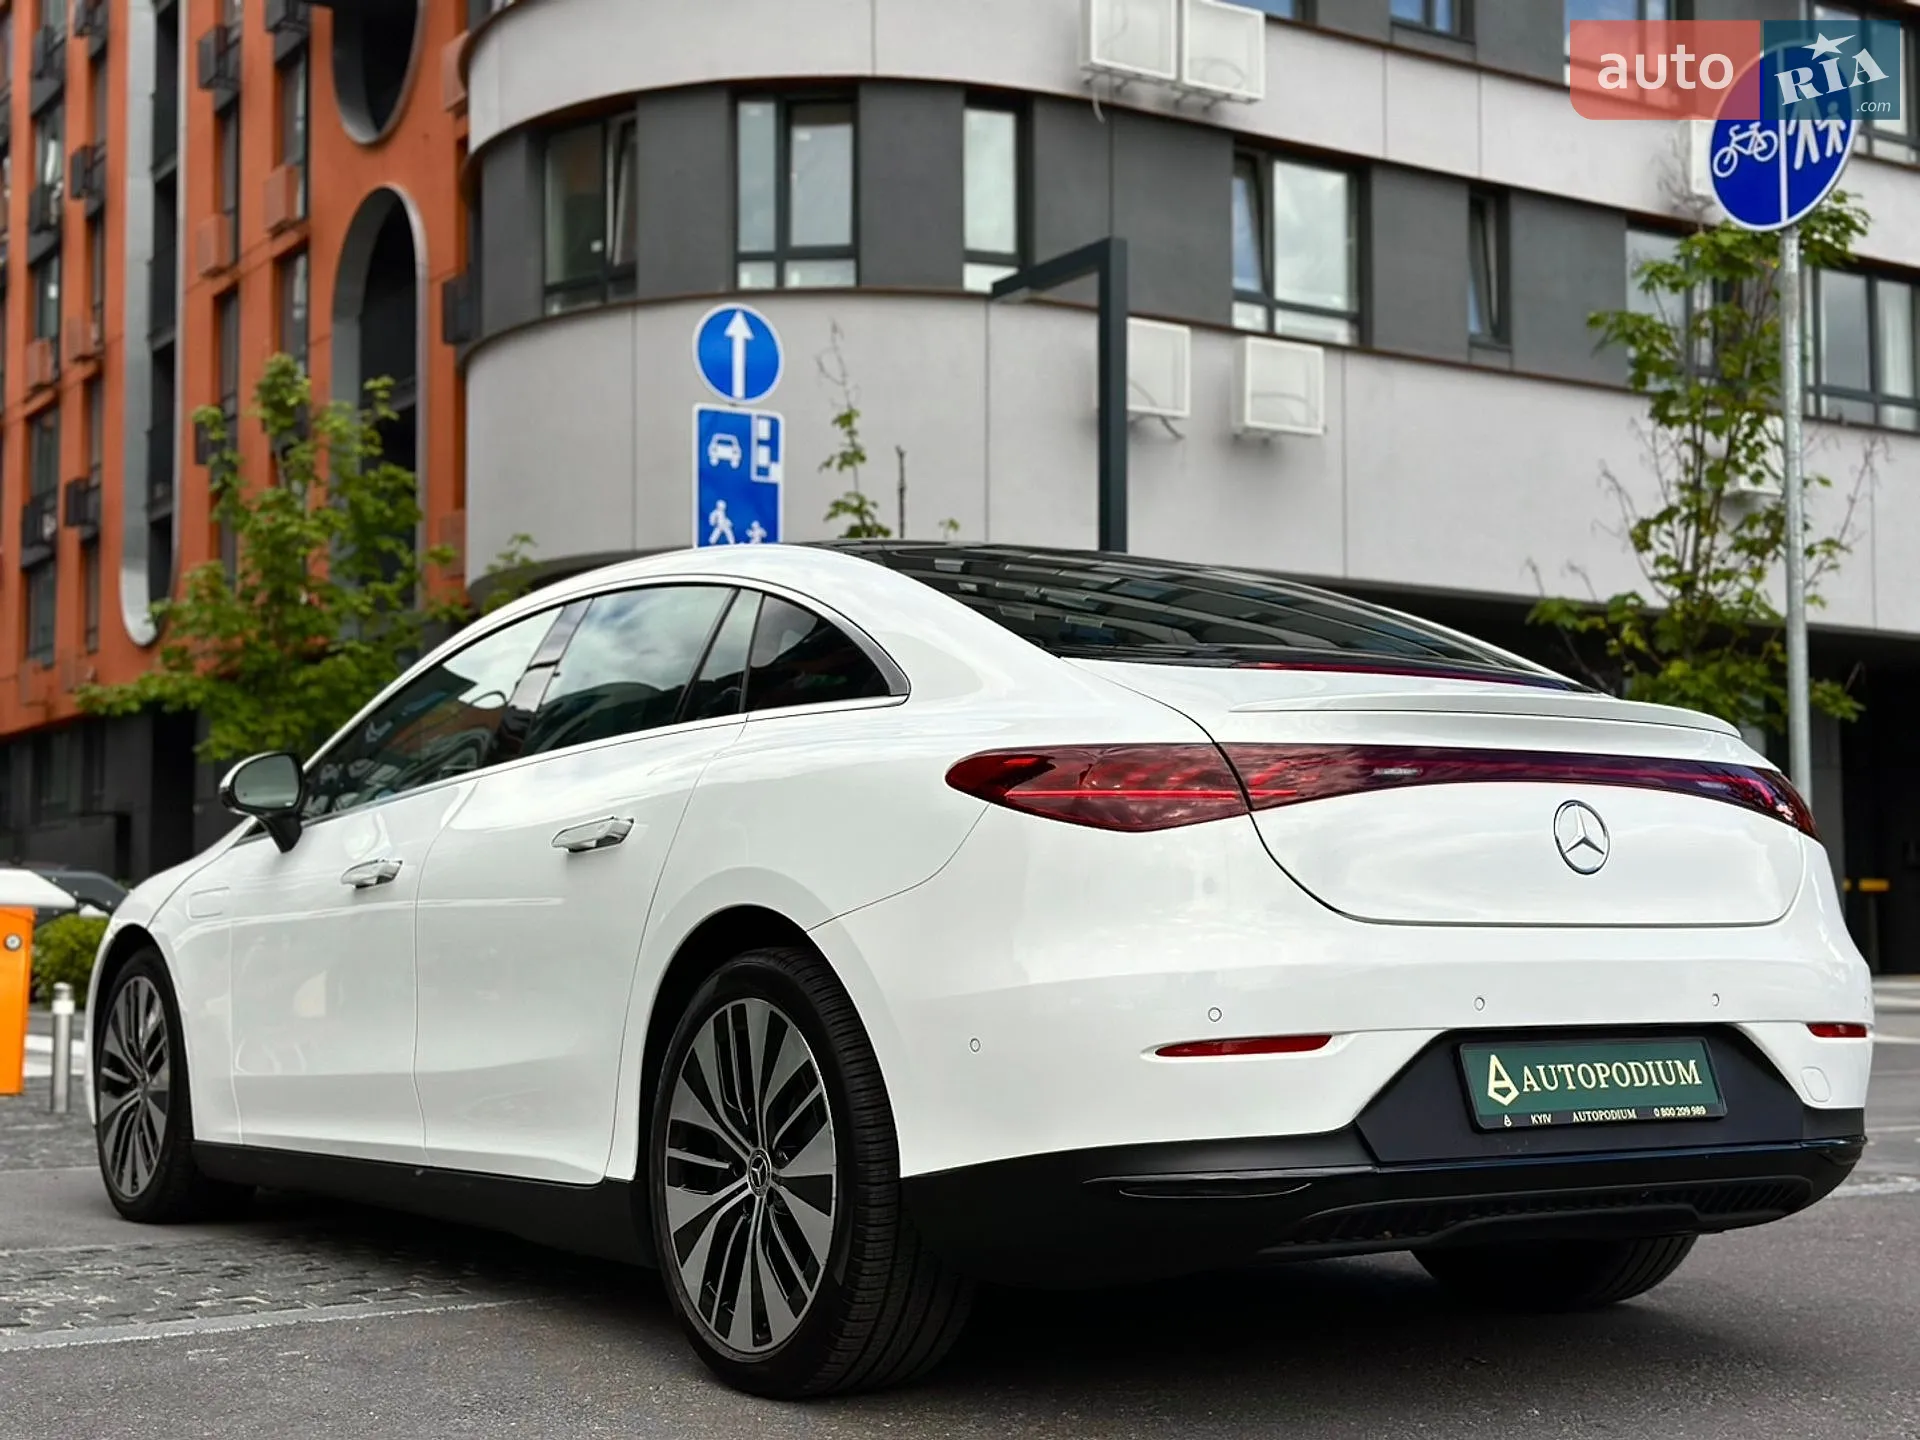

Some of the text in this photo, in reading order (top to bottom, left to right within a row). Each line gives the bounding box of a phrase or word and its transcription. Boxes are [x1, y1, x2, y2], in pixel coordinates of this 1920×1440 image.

[1522, 1059, 1702, 1092] AUTOPODIUM
[1530, 1113, 1552, 1125] KYIV
[1572, 1108, 1637, 1123] AUTOPODIUM
